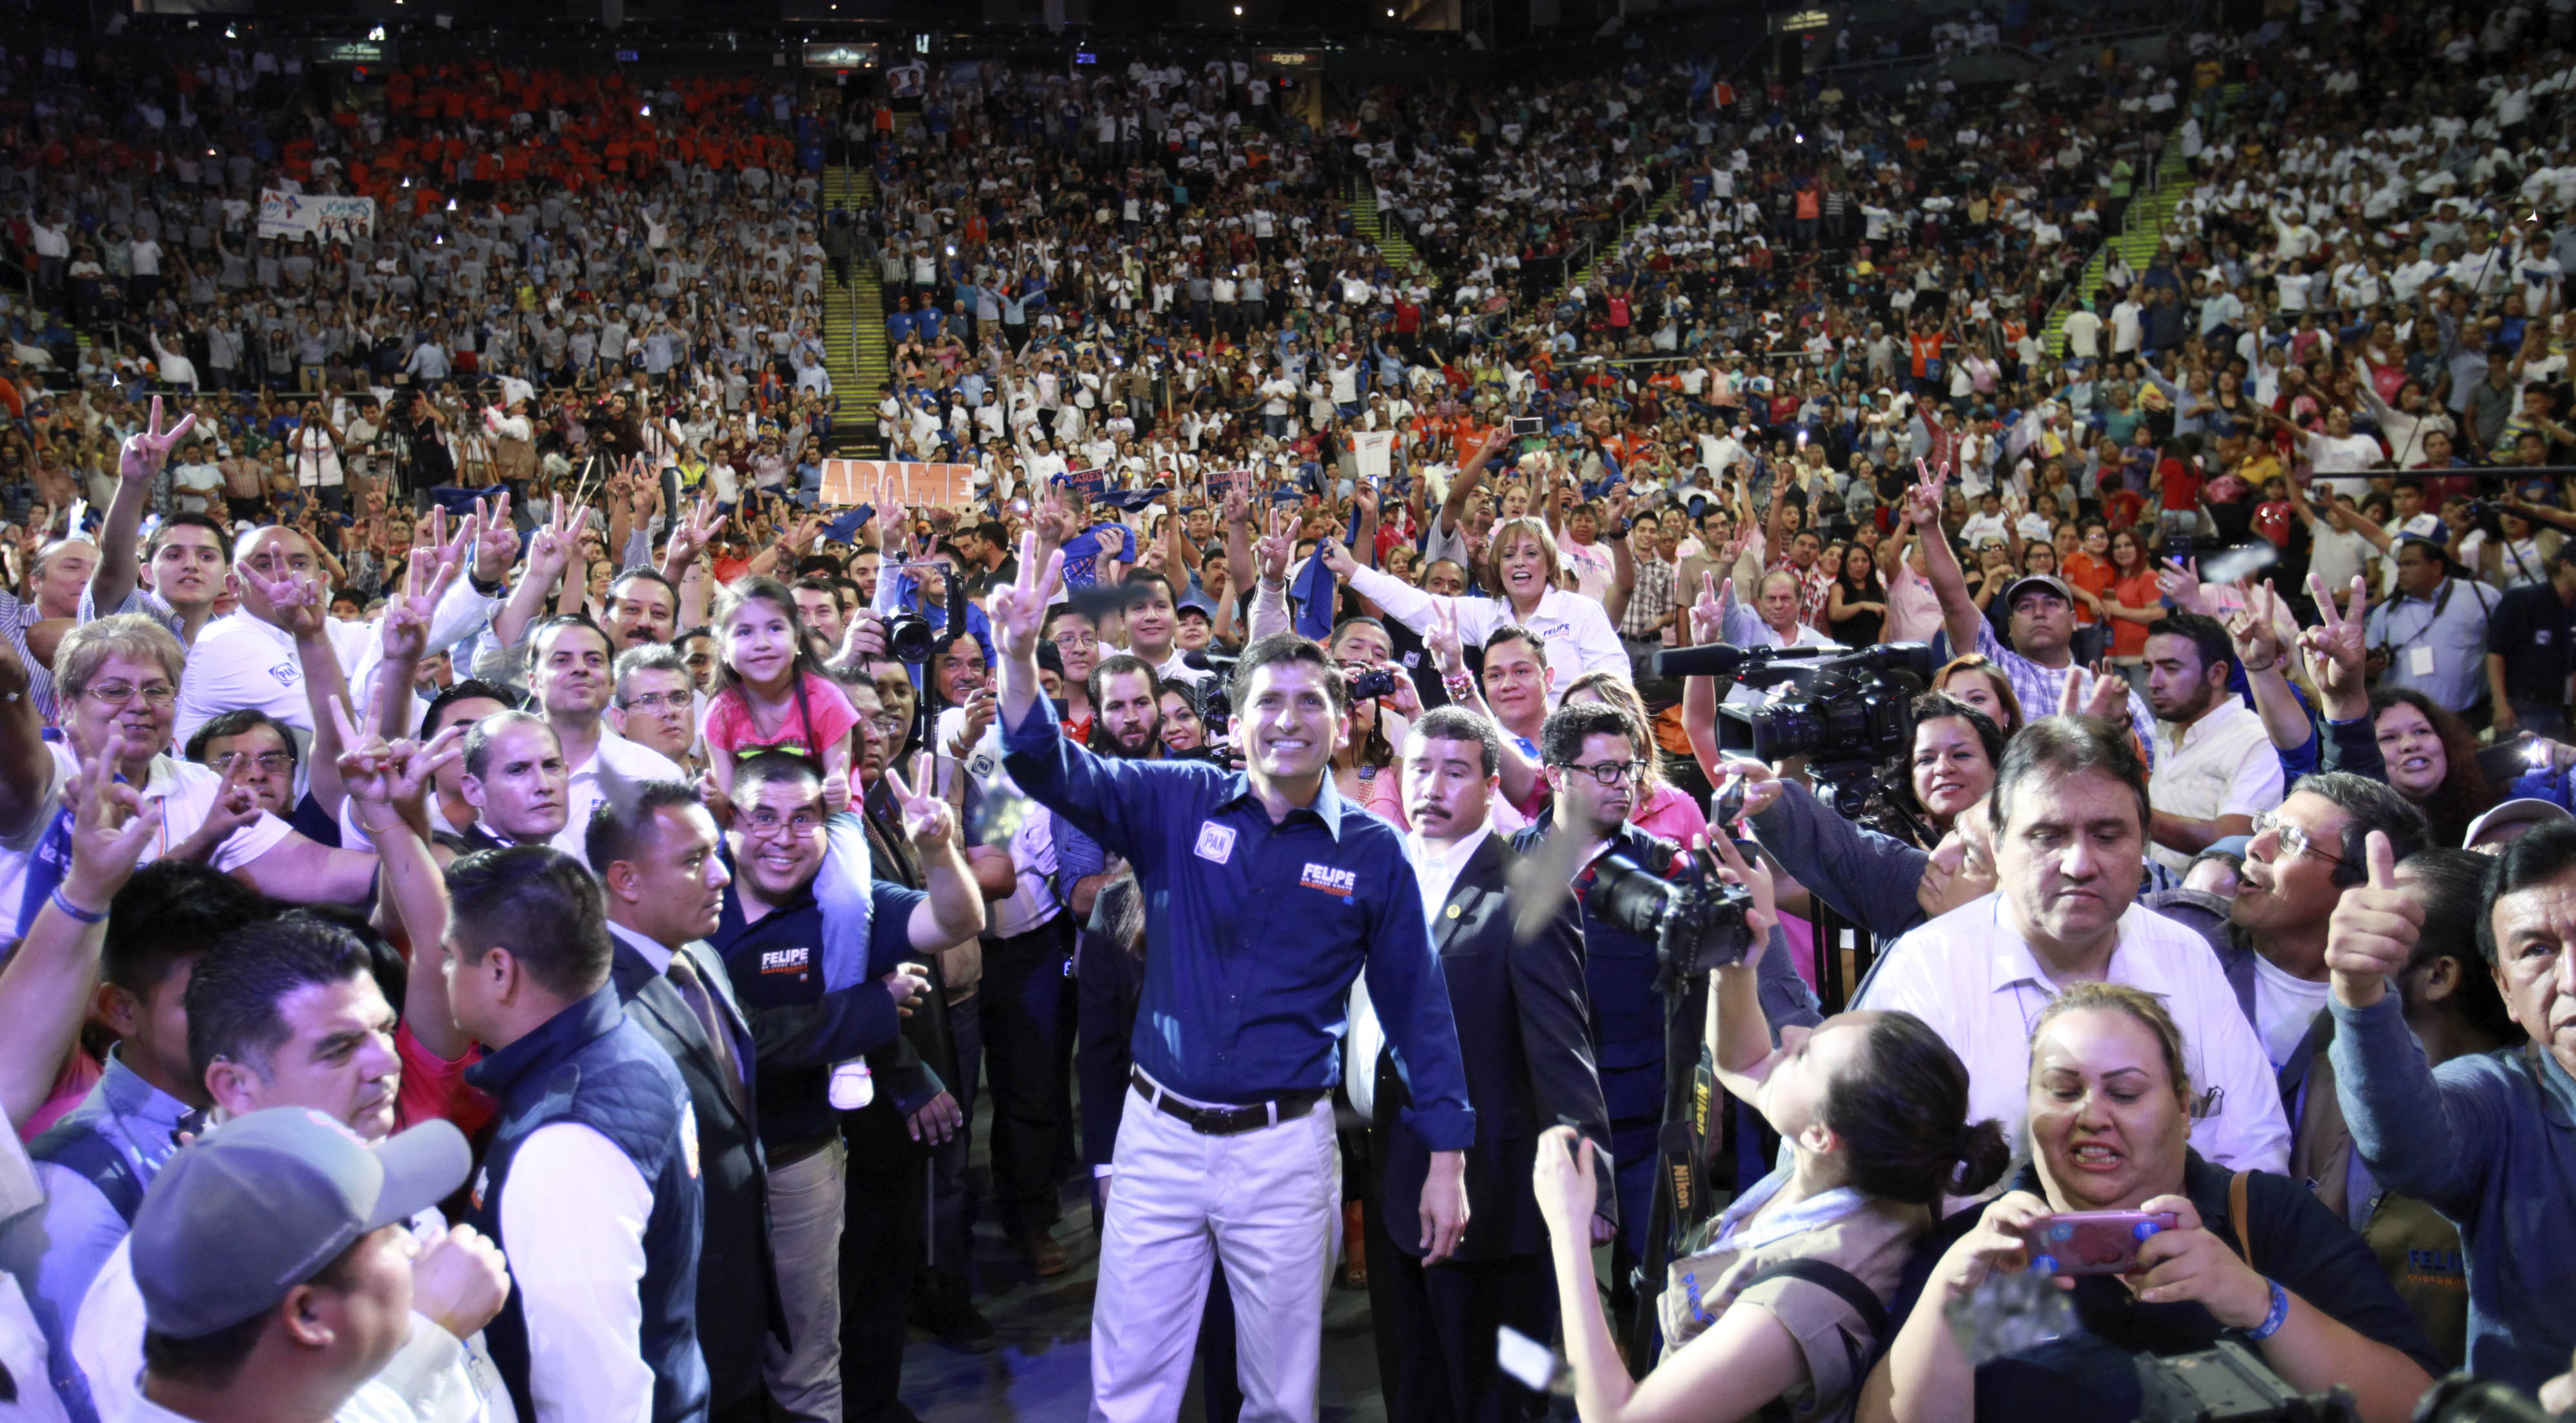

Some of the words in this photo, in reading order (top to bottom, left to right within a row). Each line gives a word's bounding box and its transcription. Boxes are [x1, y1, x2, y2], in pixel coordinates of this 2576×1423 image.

[824, 461, 972, 506] ADAME
[278, 668, 297, 680] PAN
[977, 760, 988, 771] PAN
[1203, 833, 1226, 852] PAN
[1303, 862, 1356, 886] FELIPE
[762, 947, 808, 965] FELIPE
[1697, 1082, 1708, 1136] Nikon
[1673, 1164, 1690, 1210] Nikon
